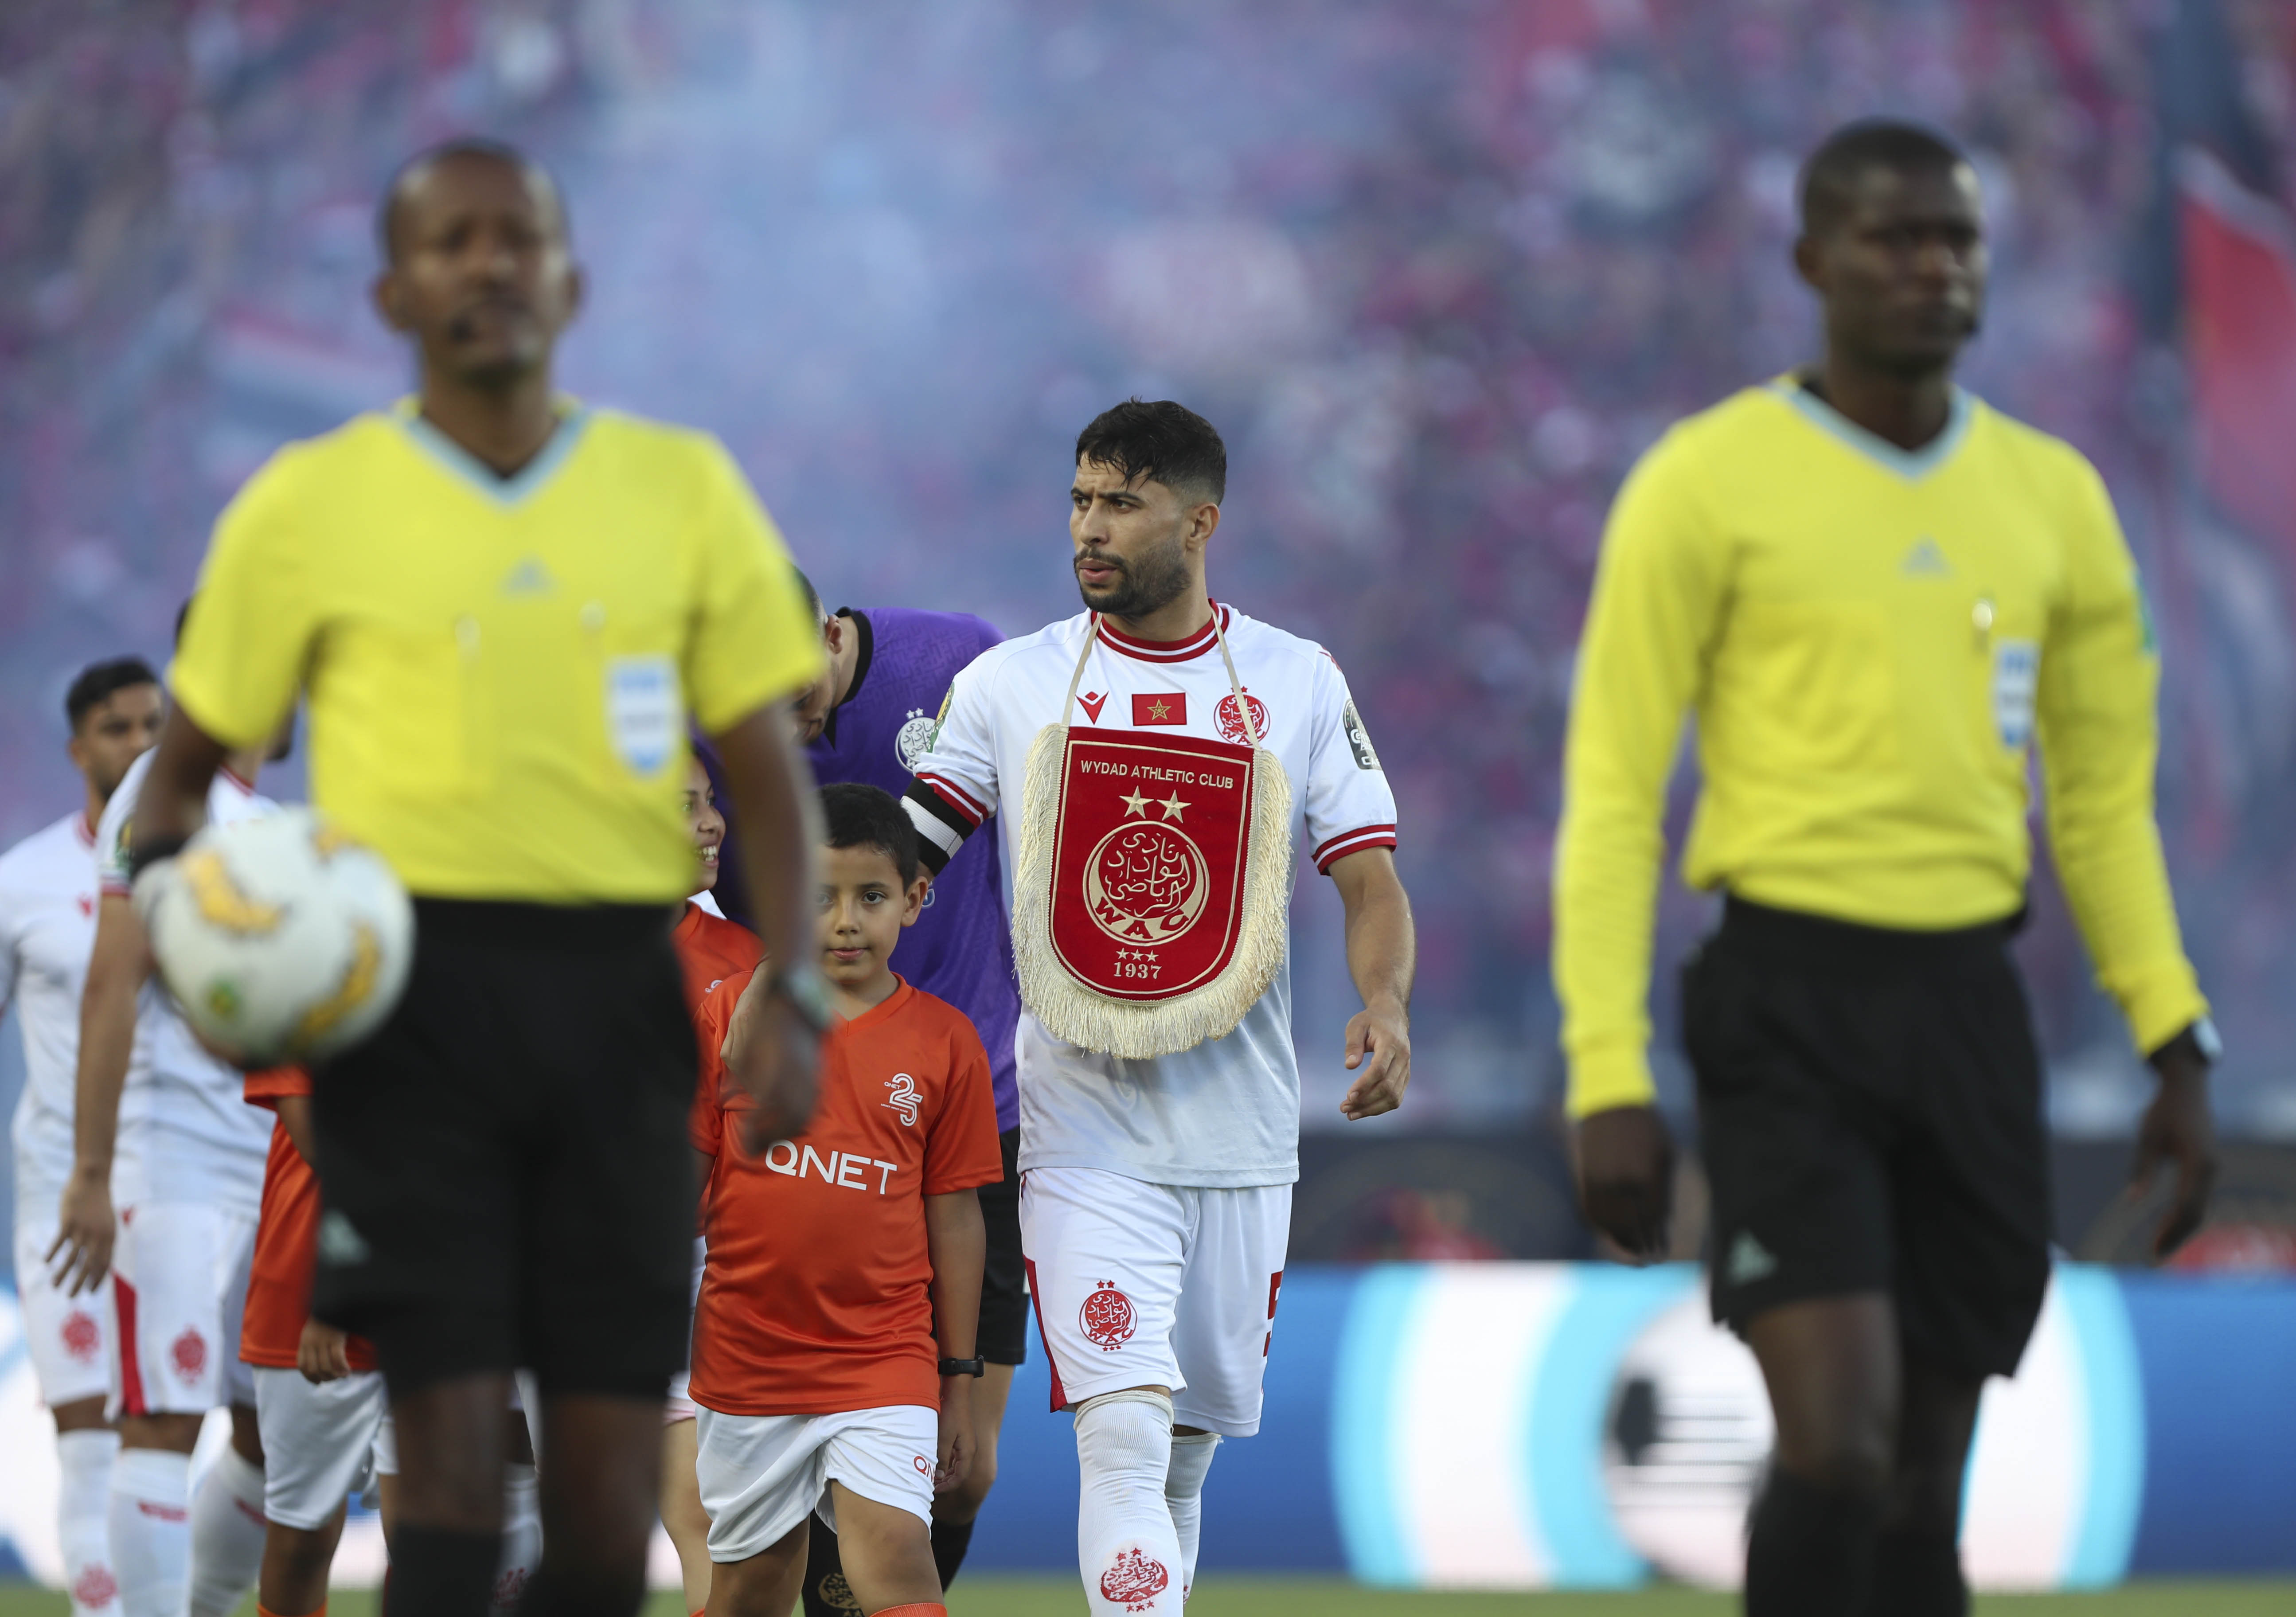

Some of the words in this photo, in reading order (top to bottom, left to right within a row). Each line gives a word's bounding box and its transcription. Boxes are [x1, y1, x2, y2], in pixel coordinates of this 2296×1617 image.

[1081, 760, 1128, 776] WYDAD
[1131, 765, 1195, 784] ATHLETIC
[1199, 773, 1234, 789] CLUB
[1113, 961, 1163, 979] 1937
[884, 1081, 901, 1090] QNET
[765, 1139, 898, 1195] QNET
